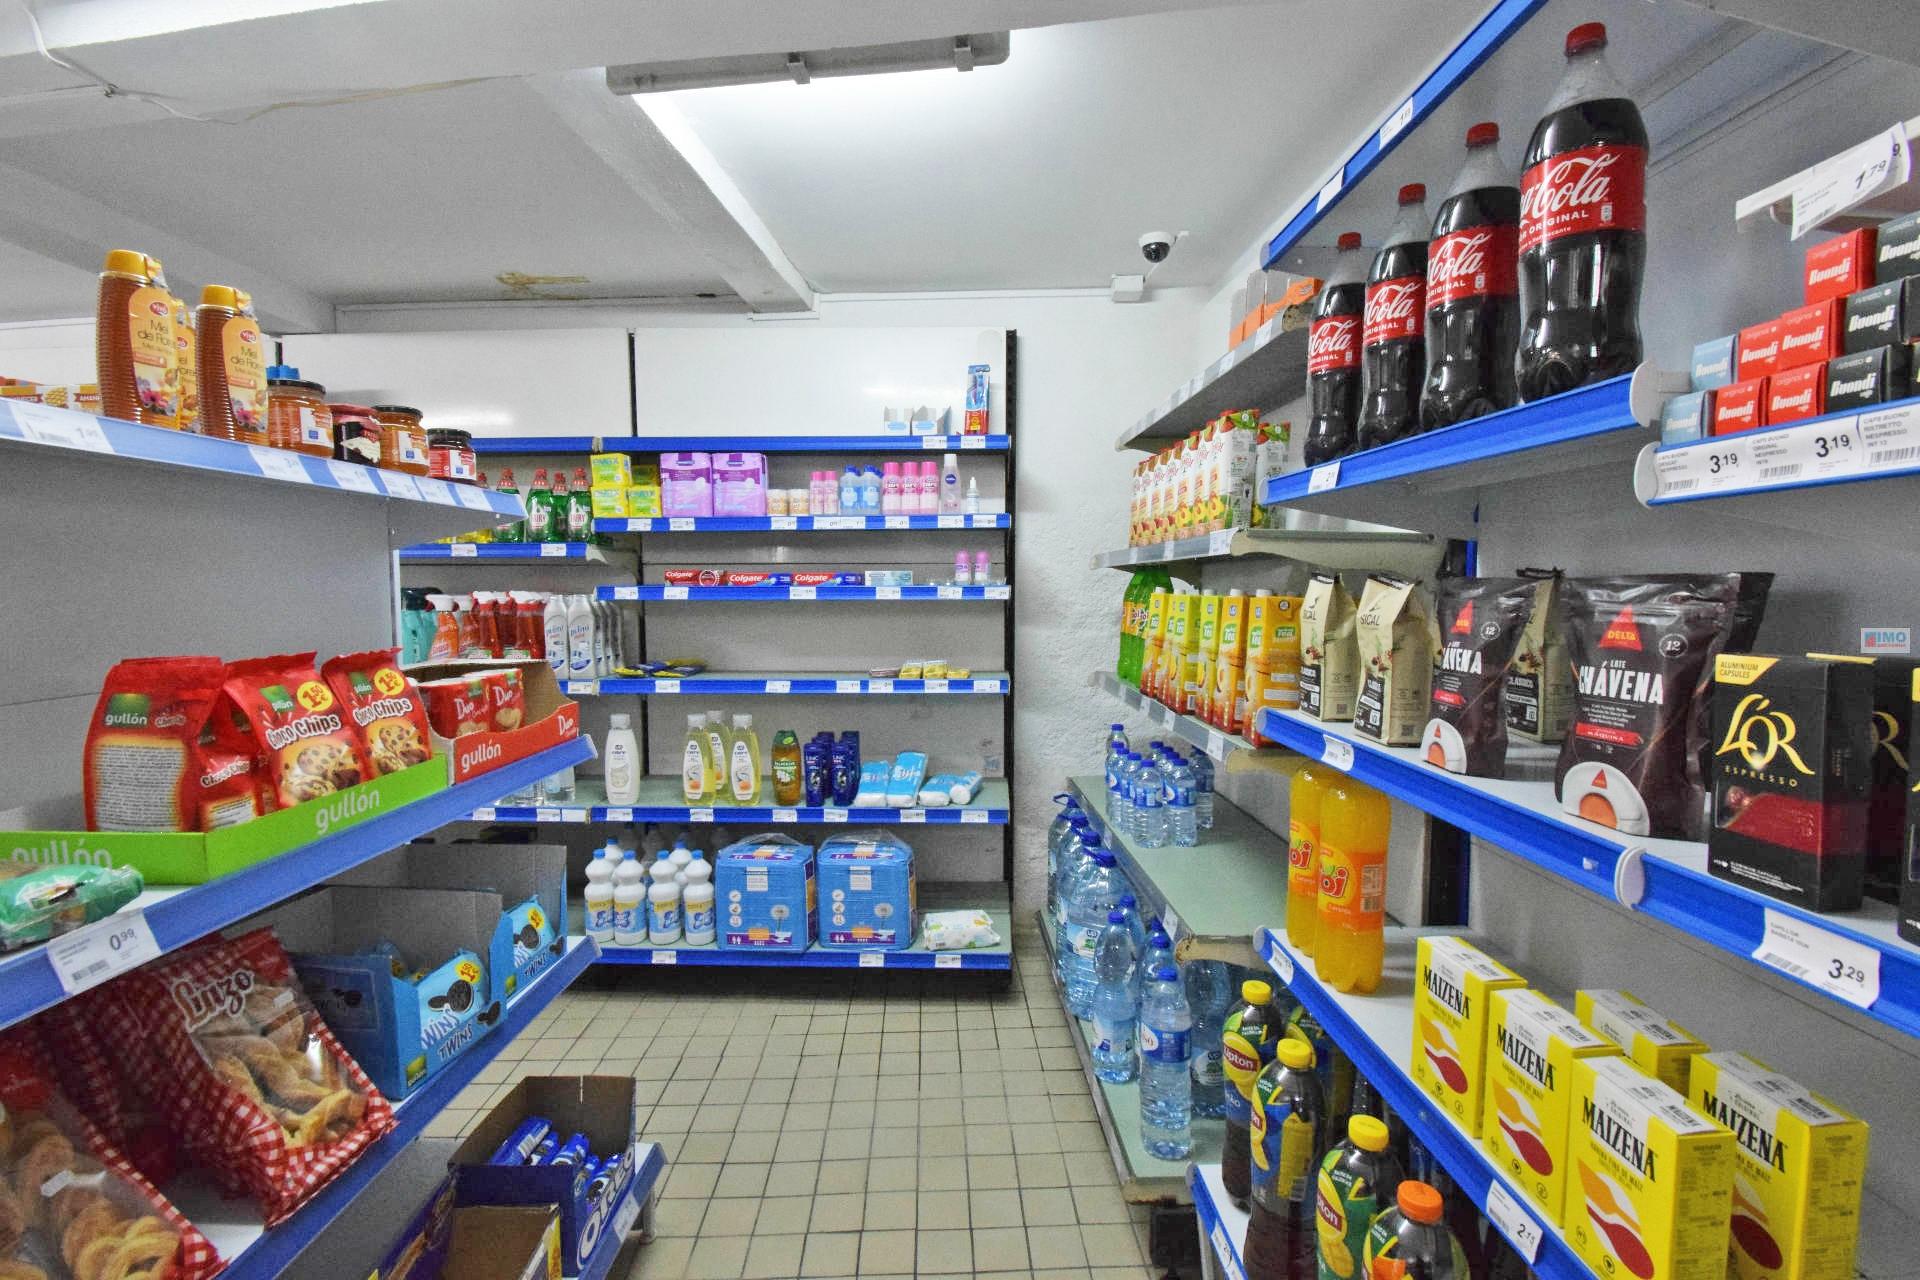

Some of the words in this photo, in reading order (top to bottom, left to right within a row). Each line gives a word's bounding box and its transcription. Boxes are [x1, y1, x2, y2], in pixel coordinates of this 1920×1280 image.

[1428, 279, 1467, 299] RIGINAL
[1363, 321, 1399, 337] RIGINAL
[1782, 326, 1825, 351] Buondi
[1741, 341, 1779, 364] Buondi
[1830, 373, 1877, 398] Buondi
[1771, 388, 1813, 411] Buondi
[1718, 400, 1755, 422] Buondi
[665, 570, 694, 579] Colgate
[729, 574, 763, 583] Colgate
[794, 574, 828, 583] Colgate
[1664, 640, 1681, 652] 12
[1719, 668, 1750, 679] CAPSULES
[1720, 661, 1759, 671] ALUMINIUM
[492, 685, 513, 706] Duo
[373, 699, 412, 717] Chips
[453, 698, 475, 720] Duo
[105, 712, 148, 727] gullón
[294, 715, 340, 737] Chips
[557, 715, 574, 736] Duo
[461, 740, 502, 773] gullón
[1725, 765, 1798, 788] ESPRESSO
[316, 787, 380, 835] gullón
[1423, 965, 1470, 1020] MAIZENA
[420, 1008, 461, 1050] WINS
[437, 1023, 473, 1062] TWINS
[1496, 1023, 1555, 1091] MAIZENA
[1582, 1095, 1656, 1183] MAIZENA
[1702, 1089, 1786, 1174] MAIZENA
